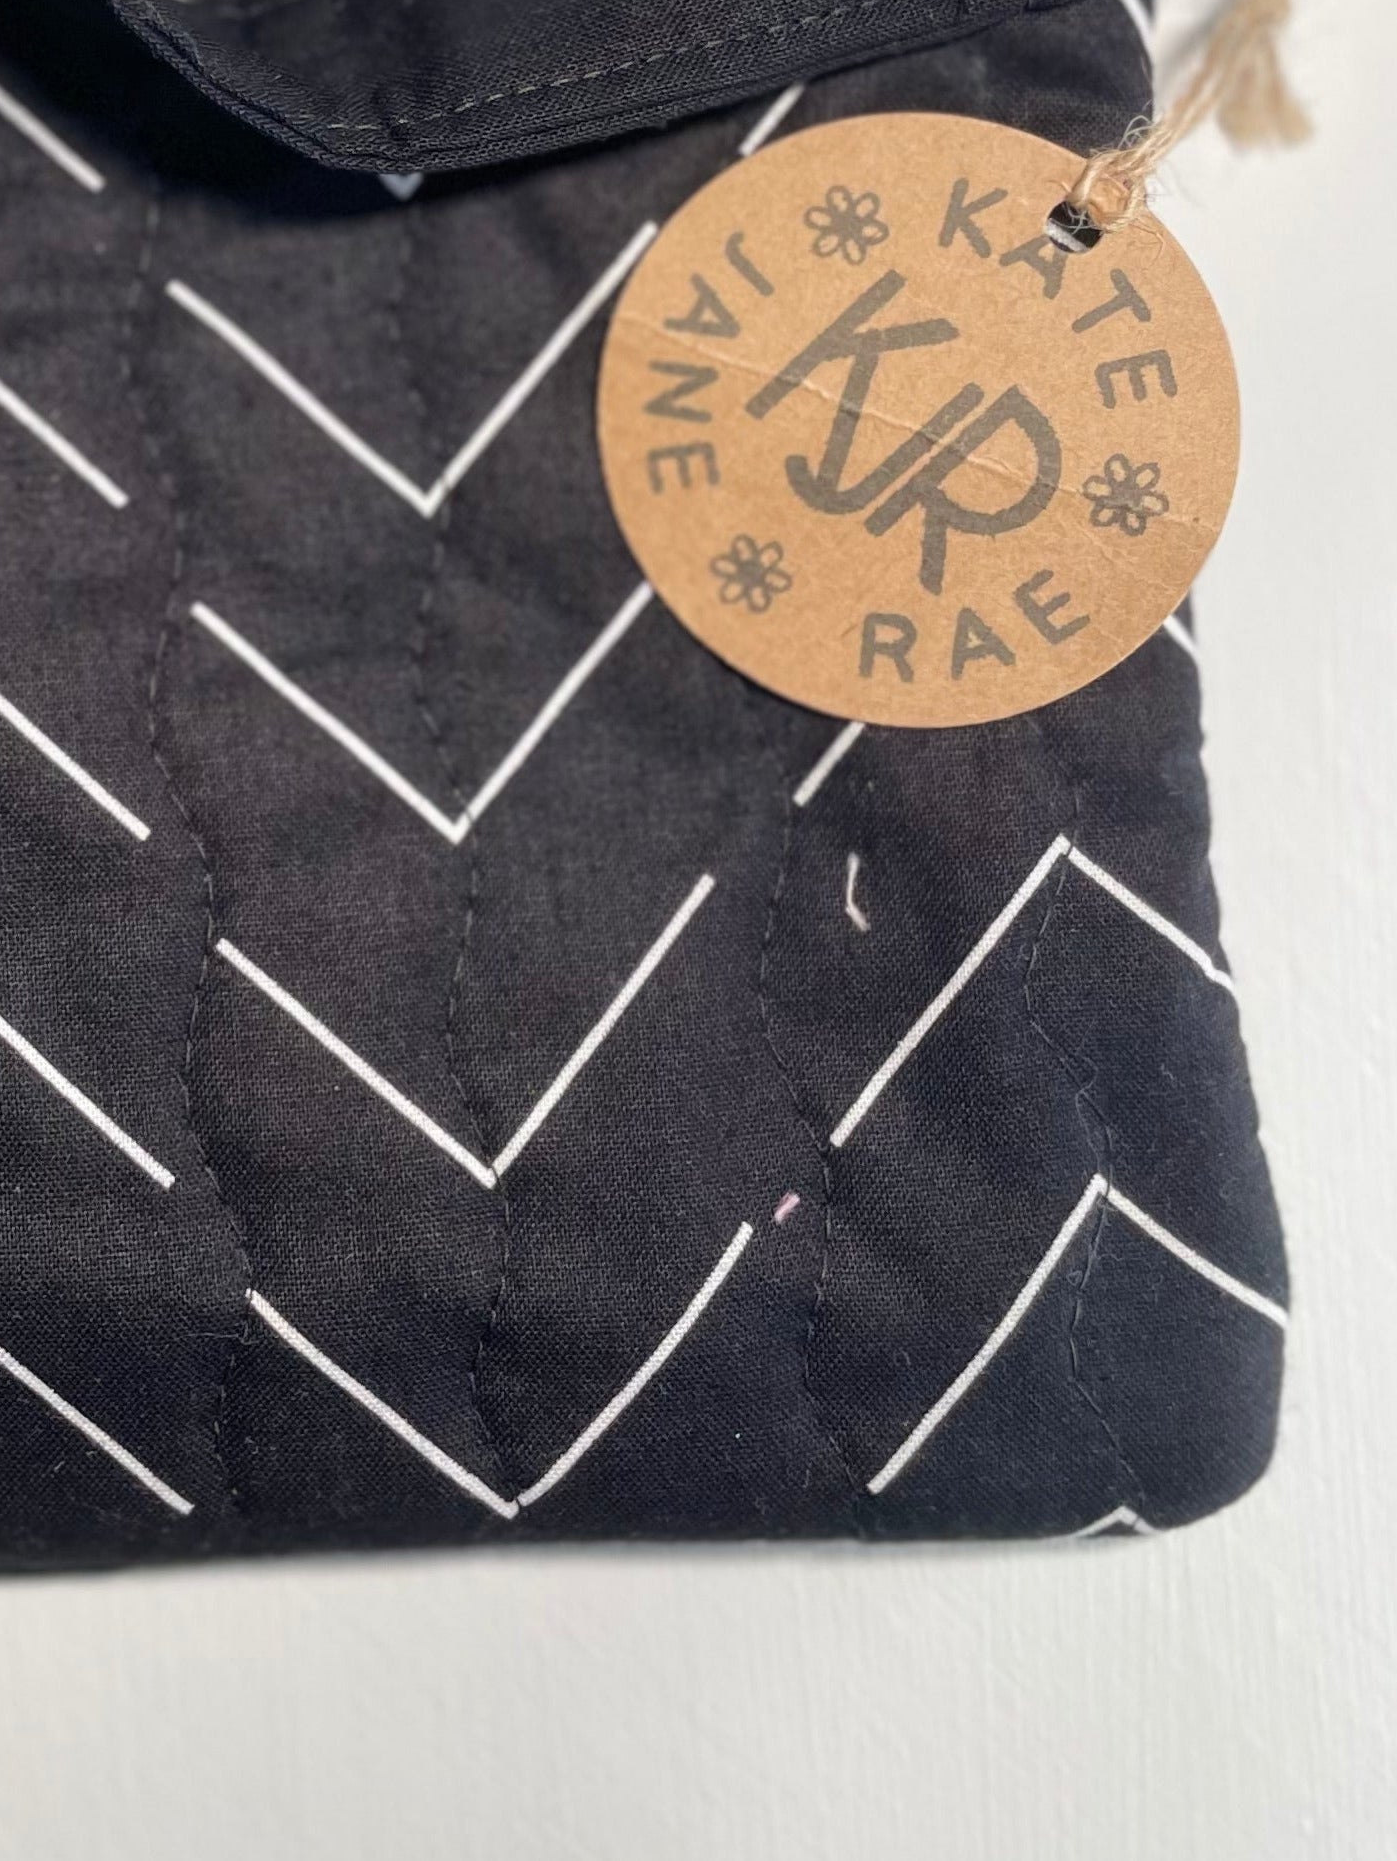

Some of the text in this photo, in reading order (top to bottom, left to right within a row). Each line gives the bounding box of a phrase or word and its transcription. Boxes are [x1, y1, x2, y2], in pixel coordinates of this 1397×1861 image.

[643, 230, 775, 496] JANE
[937, 177, 1178, 410] KATE
[858, 569, 1091, 684] RAE
